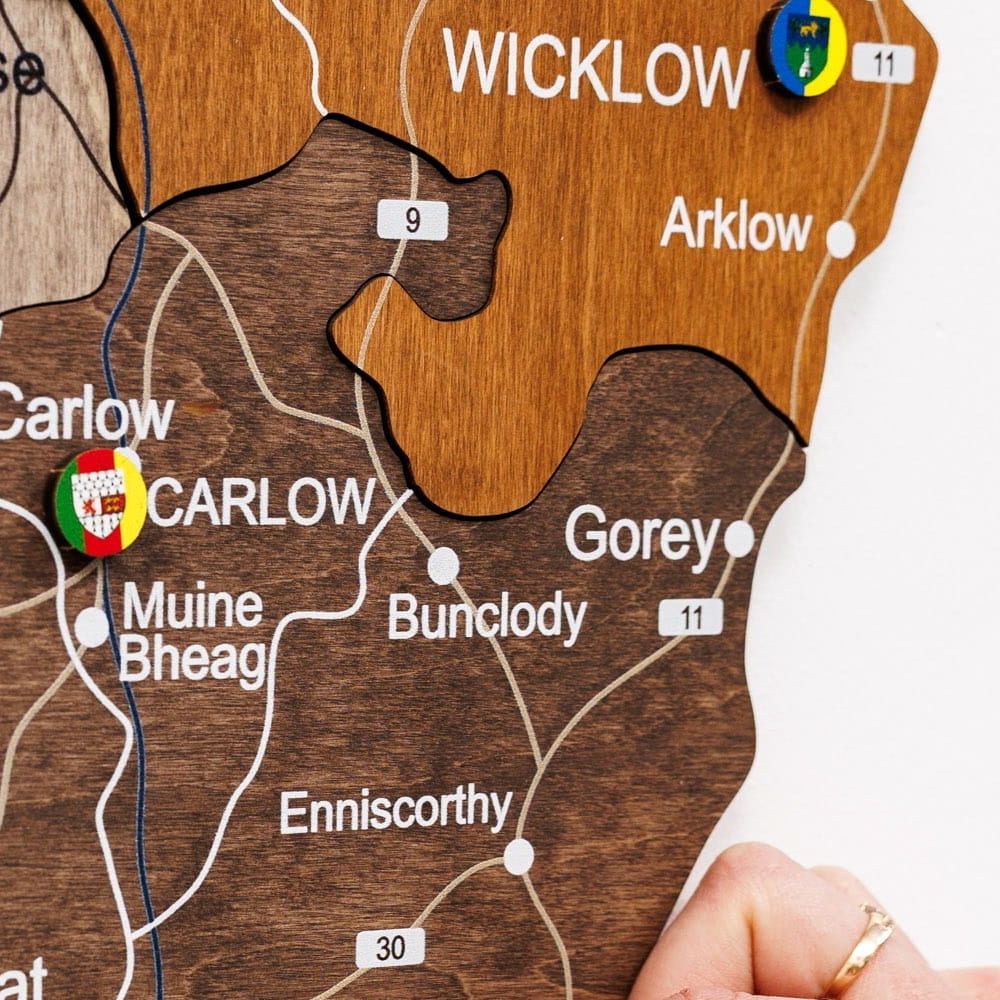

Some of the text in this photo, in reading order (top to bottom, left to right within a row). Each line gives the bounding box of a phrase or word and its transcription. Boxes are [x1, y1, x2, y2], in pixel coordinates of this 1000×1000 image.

[442, 27, 750, 110] WICKLOW
[873, 53, 895, 75] 11
[406, 207, 420, 233] 9
[660, 196, 813, 251] Arklow
[148, 477, 375, 527] CARLOW
[565, 504, 721, 575] Gorey
[123, 581, 262, 629] Muine
[388, 590, 587, 647] Bunclody
[680, 606, 703, 630] 11
[119, 634, 267, 688] Bheag
[279, 783, 513, 834] Enniscorthy
[375, 935, 406, 961] 30
